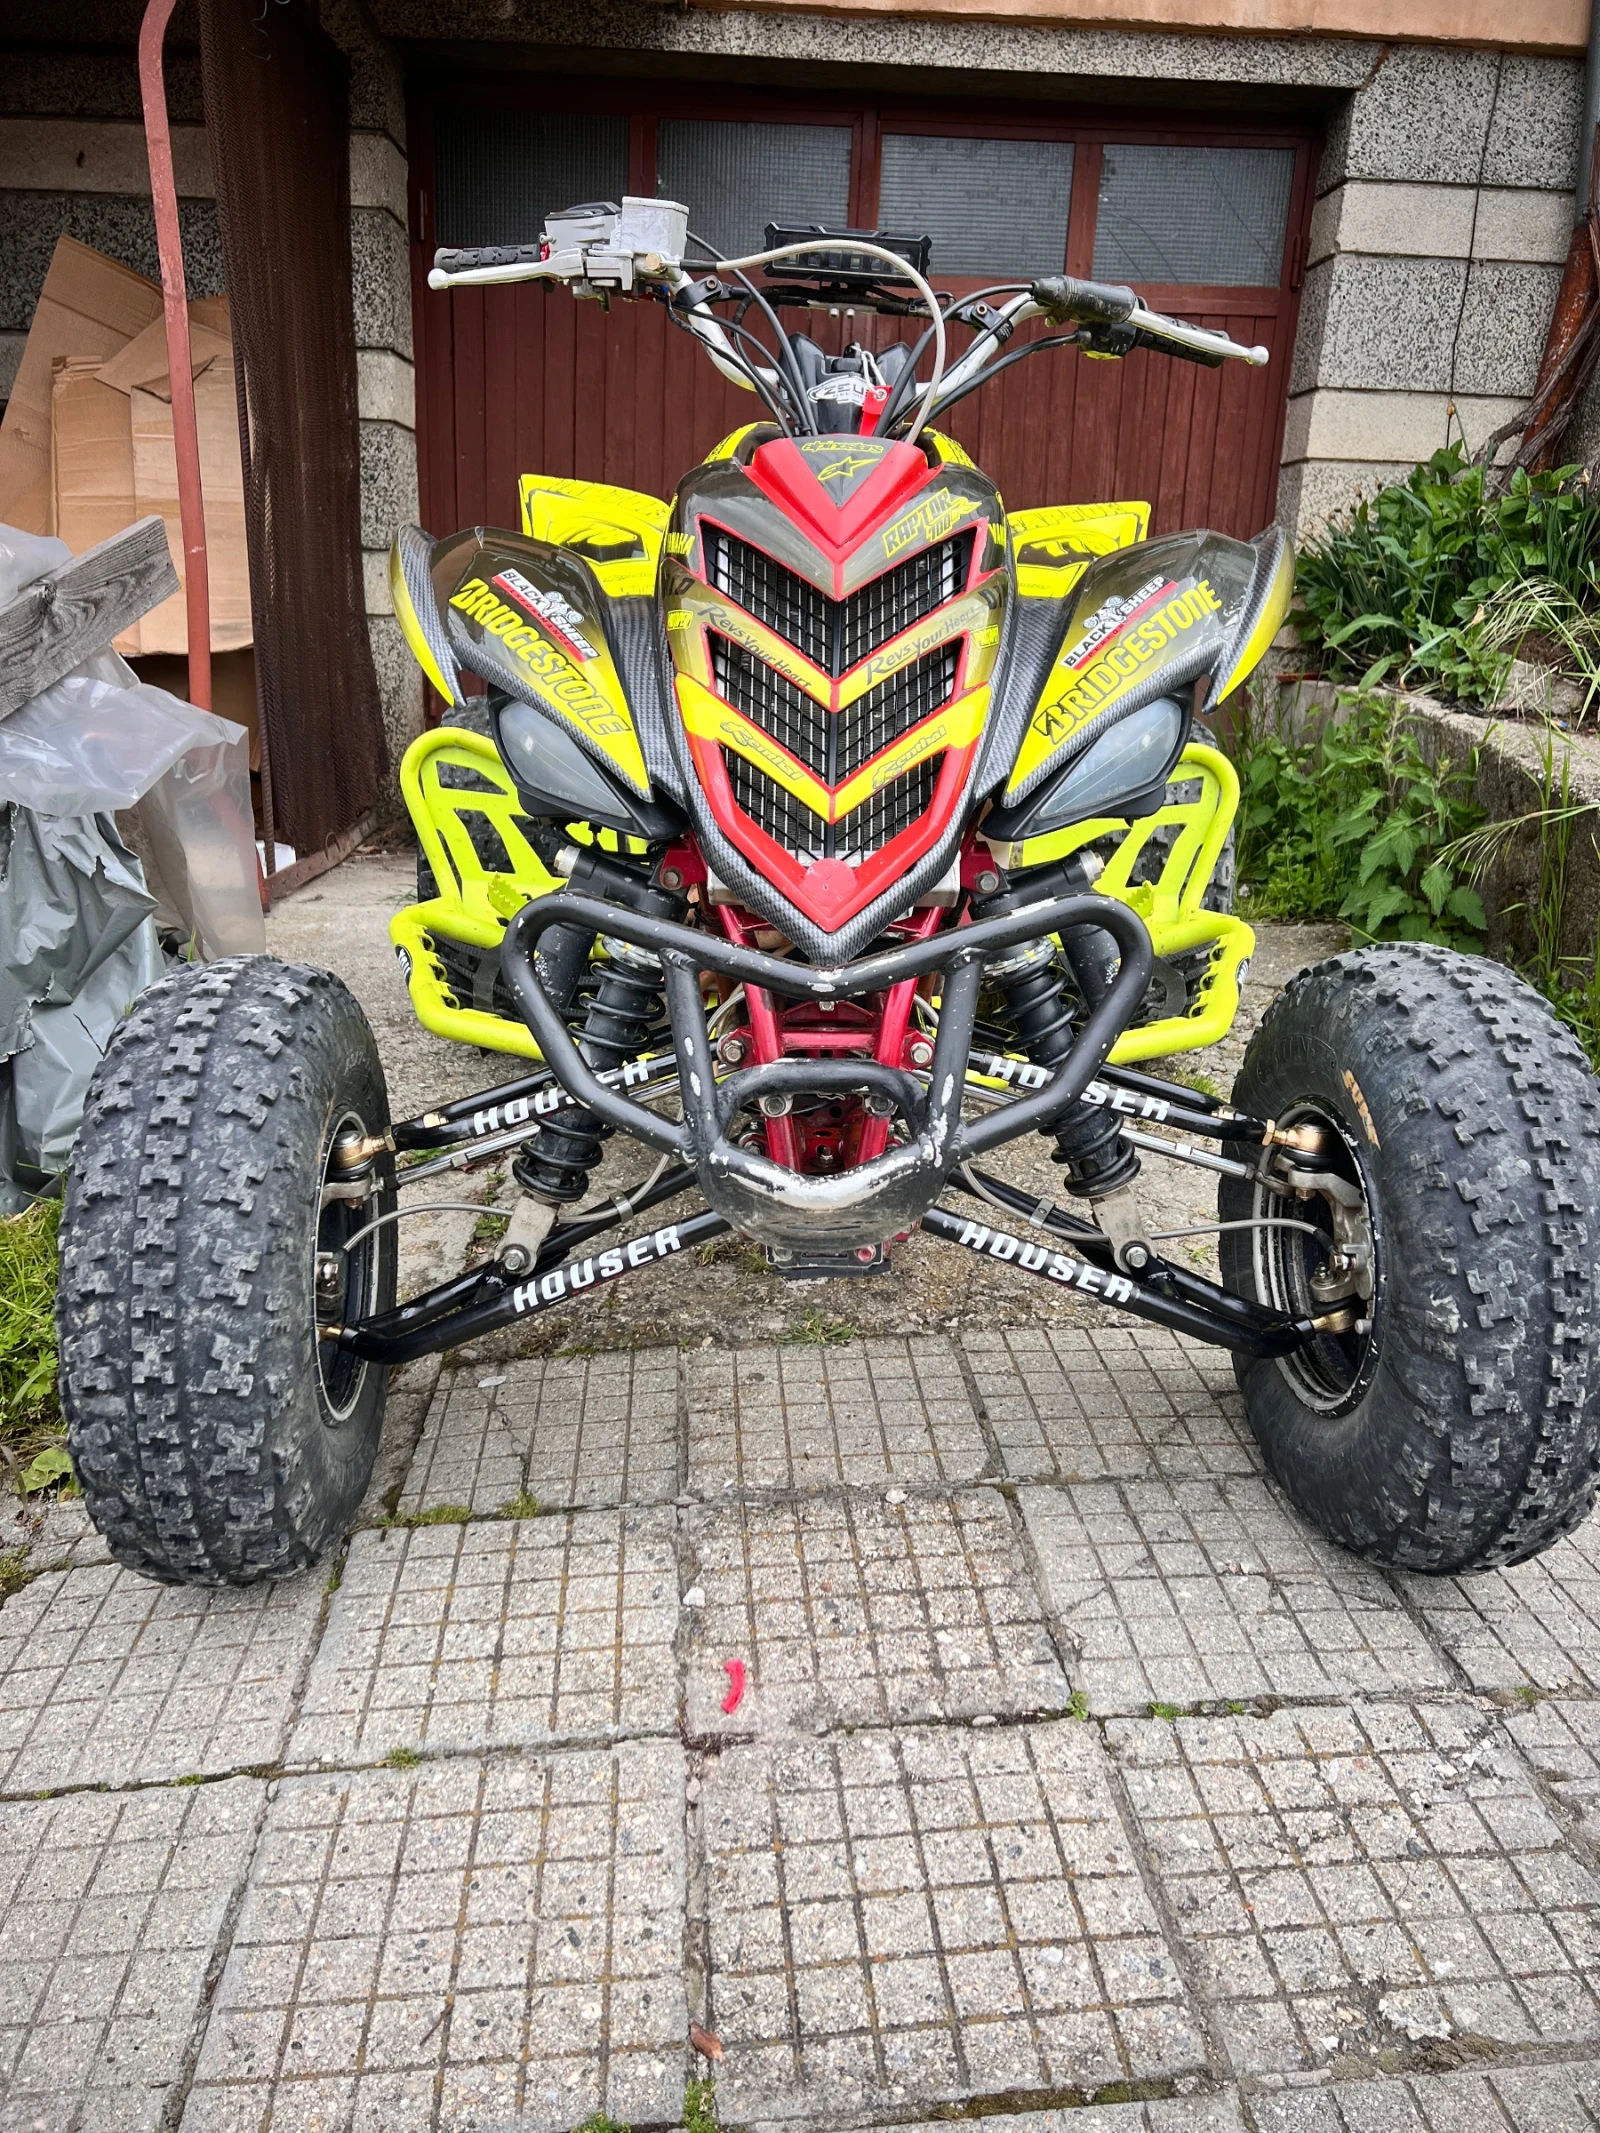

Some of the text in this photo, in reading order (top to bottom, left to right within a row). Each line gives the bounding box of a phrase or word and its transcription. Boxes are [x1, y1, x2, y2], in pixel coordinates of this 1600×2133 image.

[823, 382, 870, 396] ZEU
[883, 488, 951, 557] RAPTOR
[503, 571, 599, 657] BLACK SHEEP
[697, 601, 746, 637] Revs
[742, 635, 776, 664] Your
[774, 659, 813, 688] Heart
[859, 645, 912, 686] Revs
[911, 632, 946, 660] Your
[943, 605, 980, 635] Heart
[1063, 576, 1165, 667] BLACK SHEEP
[449, 578, 632, 736] BRIDGESTONE
[1033, 579, 1222, 745] BRIDGESTONE
[719, 721, 805, 781] Renthal
[871, 725, 948, 790] Renthal
[473, 1060, 649, 1136] HOUER
[986, 1055, 1171, 1122] HOSER
[513, 1225, 682, 1313] HOUSER
[958, 1220, 1134, 1303] HOUSER
